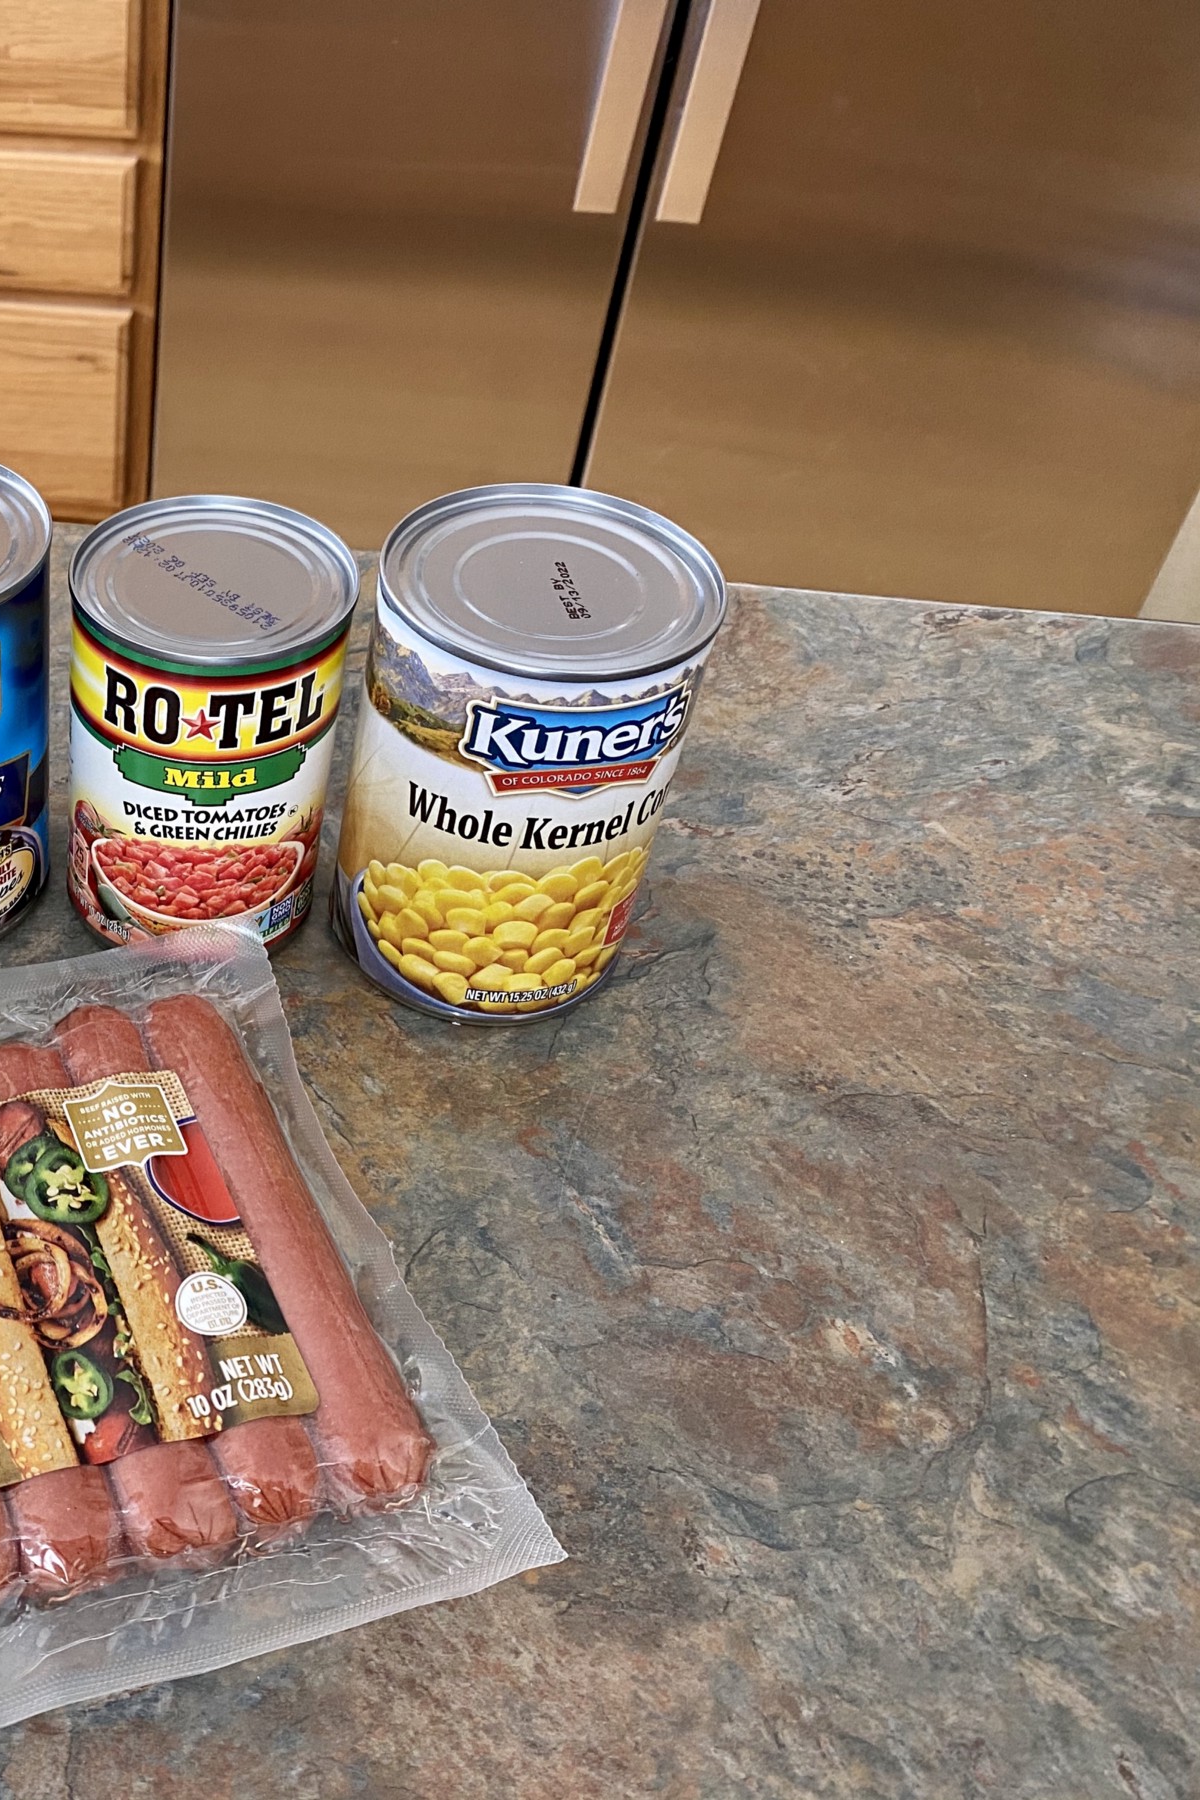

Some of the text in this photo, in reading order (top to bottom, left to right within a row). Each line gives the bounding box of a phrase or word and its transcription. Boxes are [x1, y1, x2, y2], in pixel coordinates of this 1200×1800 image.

[550, 578, 580, 619] BEST BY
[554, 561, 592, 619] 09/13/2022
[470, 696, 684, 766] Kuner's
[164, 767, 257, 789] Mild
[502, 765, 648, 786] OF COLORADO SINCE 1864
[123, 801, 287, 824] DICED TOMATOES
[408, 780, 513, 847] Whole
[519, 801, 635, 850] Kernel
[135, 821, 278, 840] & GREEN CHILIES
[272, 905, 291, 921] GMO
[273, 897, 292, 914] NON
[466, 989, 547, 1003] NET WT 15.25 OZ
[80, 1104, 100, 1114] BEEF
[101, 1094, 129, 1108] RAISED
[102, 1101, 137, 1123] NO
[100, 1132, 127, 1146] ADDED
[127, 1125, 172, 1135] HORMONES
[102, 1133, 166, 1161] EVER
[190, 1279, 223, 1293] U.S.
[218, 1354, 284, 1381] NET WT
[187, 1375, 294, 1418] 10 OZ (283g)
